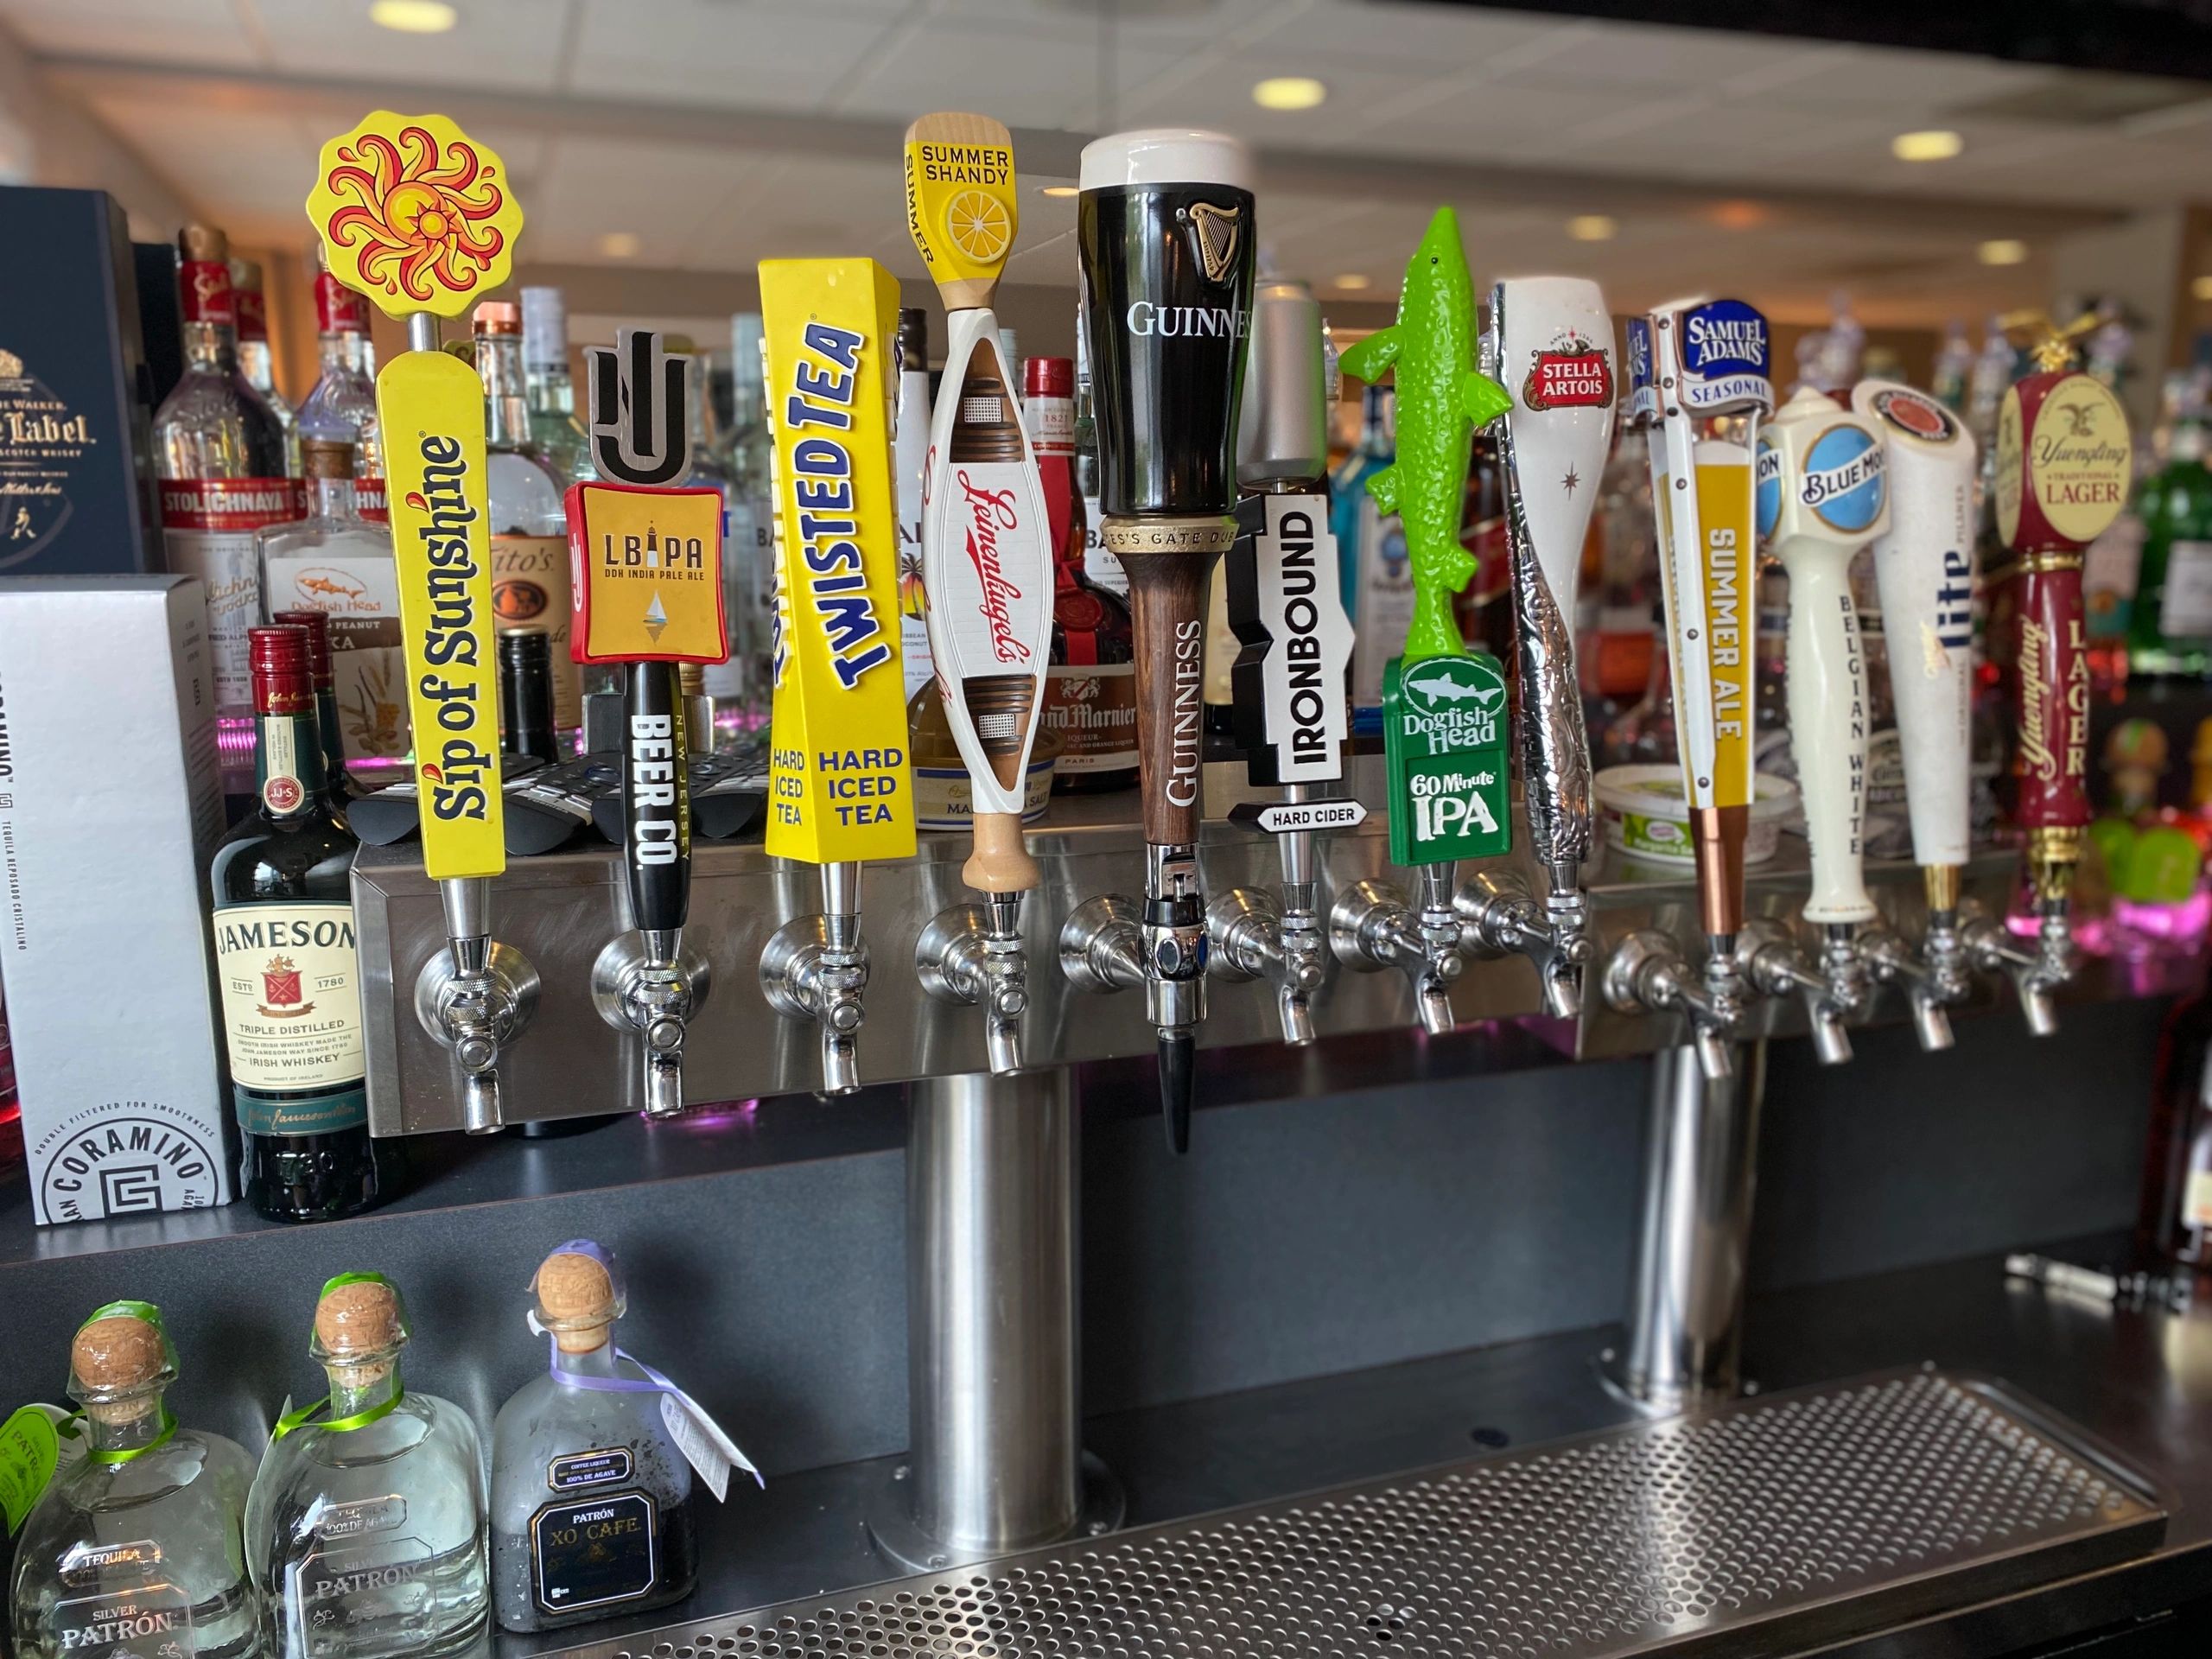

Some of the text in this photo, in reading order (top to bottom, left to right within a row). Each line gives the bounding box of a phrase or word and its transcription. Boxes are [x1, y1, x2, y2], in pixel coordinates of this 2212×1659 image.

[922, 145, 1009, 168] SUMMER
[925, 164, 1009, 186] SHANDY
[906, 154, 934, 264] SUMMER
[1126, 301, 1252, 339] GUINNES
[1689, 316, 1766, 345] SAMUEL
[1696, 340, 1764, 366] ADAMS
[786, 321, 864, 430] TEA
[1542, 362, 1602, 379] STELLA
[1542, 379, 1603, 397] ARTOIS
[1691, 380, 1767, 404] SEASONAL
[1046, 414, 1068, 423] 1821
[1802, 465, 1860, 505] BLUE
[2045, 482, 2121, 505] LAGER
[164, 491, 284, 512] STOLICHNAYA
[1151, 532, 1202, 545] GATE
[1210, 531, 1235, 543] DUB
[604, 569, 704, 581] DDH INDIA PALE ALE
[793, 438, 892, 690] TWISTED
[346, 601, 381, 612] Head
[335, 620, 381, 630] PEANUT
[406, 435, 491, 821] Sip of Sunshine
[1708, 527, 1742, 742] SUMMER ALE
[1279, 511, 1327, 765] IRONBOUND
[2067, 620, 2089, 776] LAGER
[1068, 702, 1136, 729] Marnier
[1166, 620, 1202, 808] GUINNESS
[1403, 706, 1488, 736] Dogfish
[1839, 595, 1865, 855] BELGIAN WHITE
[1427, 719, 1496, 755] Head
[631, 715, 675, 809] BEER
[772, 748, 805, 772] HARD
[818, 747, 904, 772] HARD
[675, 715, 690, 861] NEW JERSEY
[774, 774, 804, 798] ICED
[828, 775, 897, 800] ICED
[1409, 770, 1495, 797] 60 Minute
[1029, 791, 1048, 808] SALT
[775, 803, 803, 827] TEA
[835, 803, 893, 827] TEA
[1273, 808, 1356, 827] HARD CIDER
[1411, 791, 1499, 842] IPA
[3, 820, 27, 951] TEQUILA REPOSADO CRISTALINO
[219, 919, 355, 956] JAMESON
[317, 976, 345, 989] 1780
[238, 1020, 346, 1035] TRIPLE DISTILLED
[280, 1039, 315, 1048] WHISKEY
[315, 1035, 338, 1046] MADE
[306, 1045, 330, 1054] SINCE
[250, 1052, 340, 1068] IRISH WHISKEY
[34, 1124, 67, 1156] DOUBLE
[69, 1102, 120, 1125] FILTERED
[152, 1103, 215, 1138] SMOOTHNESS
[53, 1126, 205, 1192] CORAMINO
[566, 1474, 583, 1484] 100%
[594, 1469, 617, 1479] AGAVE
[572, 1508, 615, 1524] PATRÓN
[550, 1529, 578, 1547] XO
[82, 1548, 141, 1567] TEQUILA
[92, 1604, 138, 1622] SILVER
[61, 1610, 174, 1650] PATRÓN
